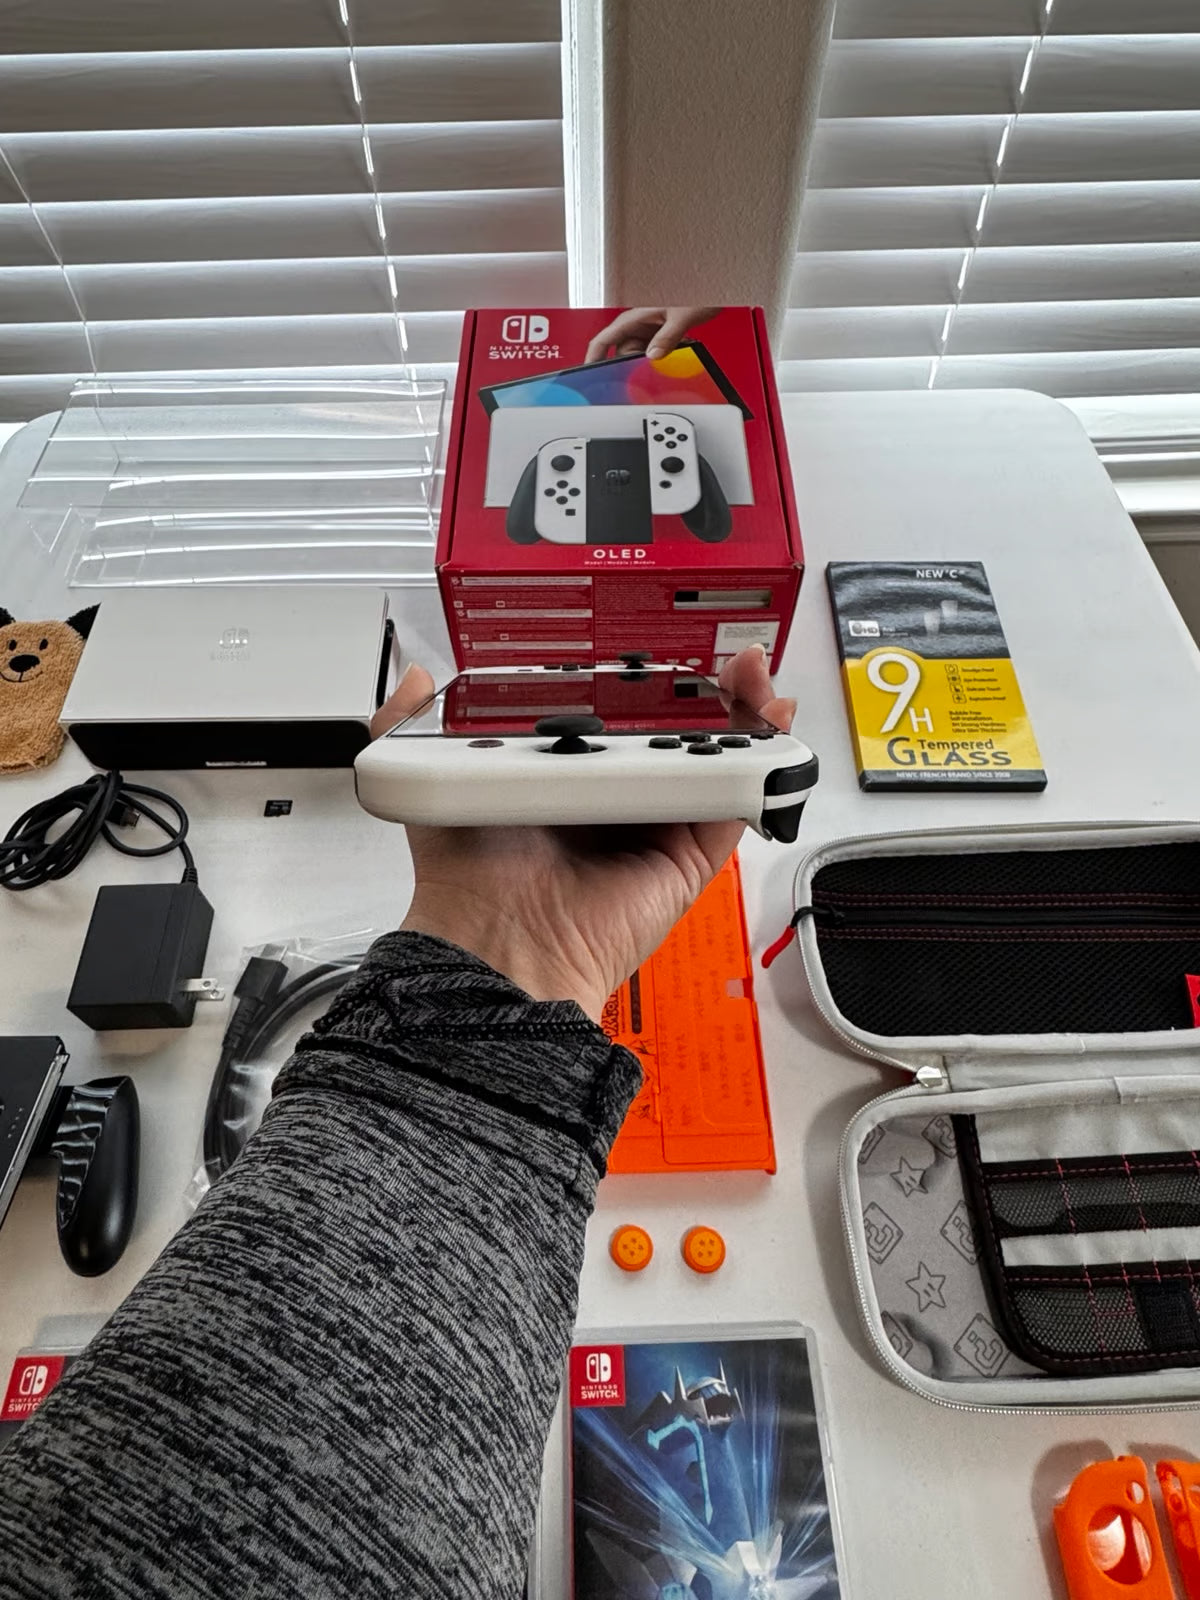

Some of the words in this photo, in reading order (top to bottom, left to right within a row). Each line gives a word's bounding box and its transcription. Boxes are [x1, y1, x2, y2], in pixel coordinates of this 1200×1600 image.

[488, 350, 560, 360] SWITCH
[593, 549, 647, 559] OLED
[917, 738, 994, 753] Tempered
[887, 736, 1012, 766] GLASS
[919, 771, 947, 779] FRENCH
[947, 771, 972, 779] BRAND
[973, 771, 993, 779] SINCE
[581, 1390, 618, 1399] SWITCH
[8, 1402, 40, 1412] SWITC
